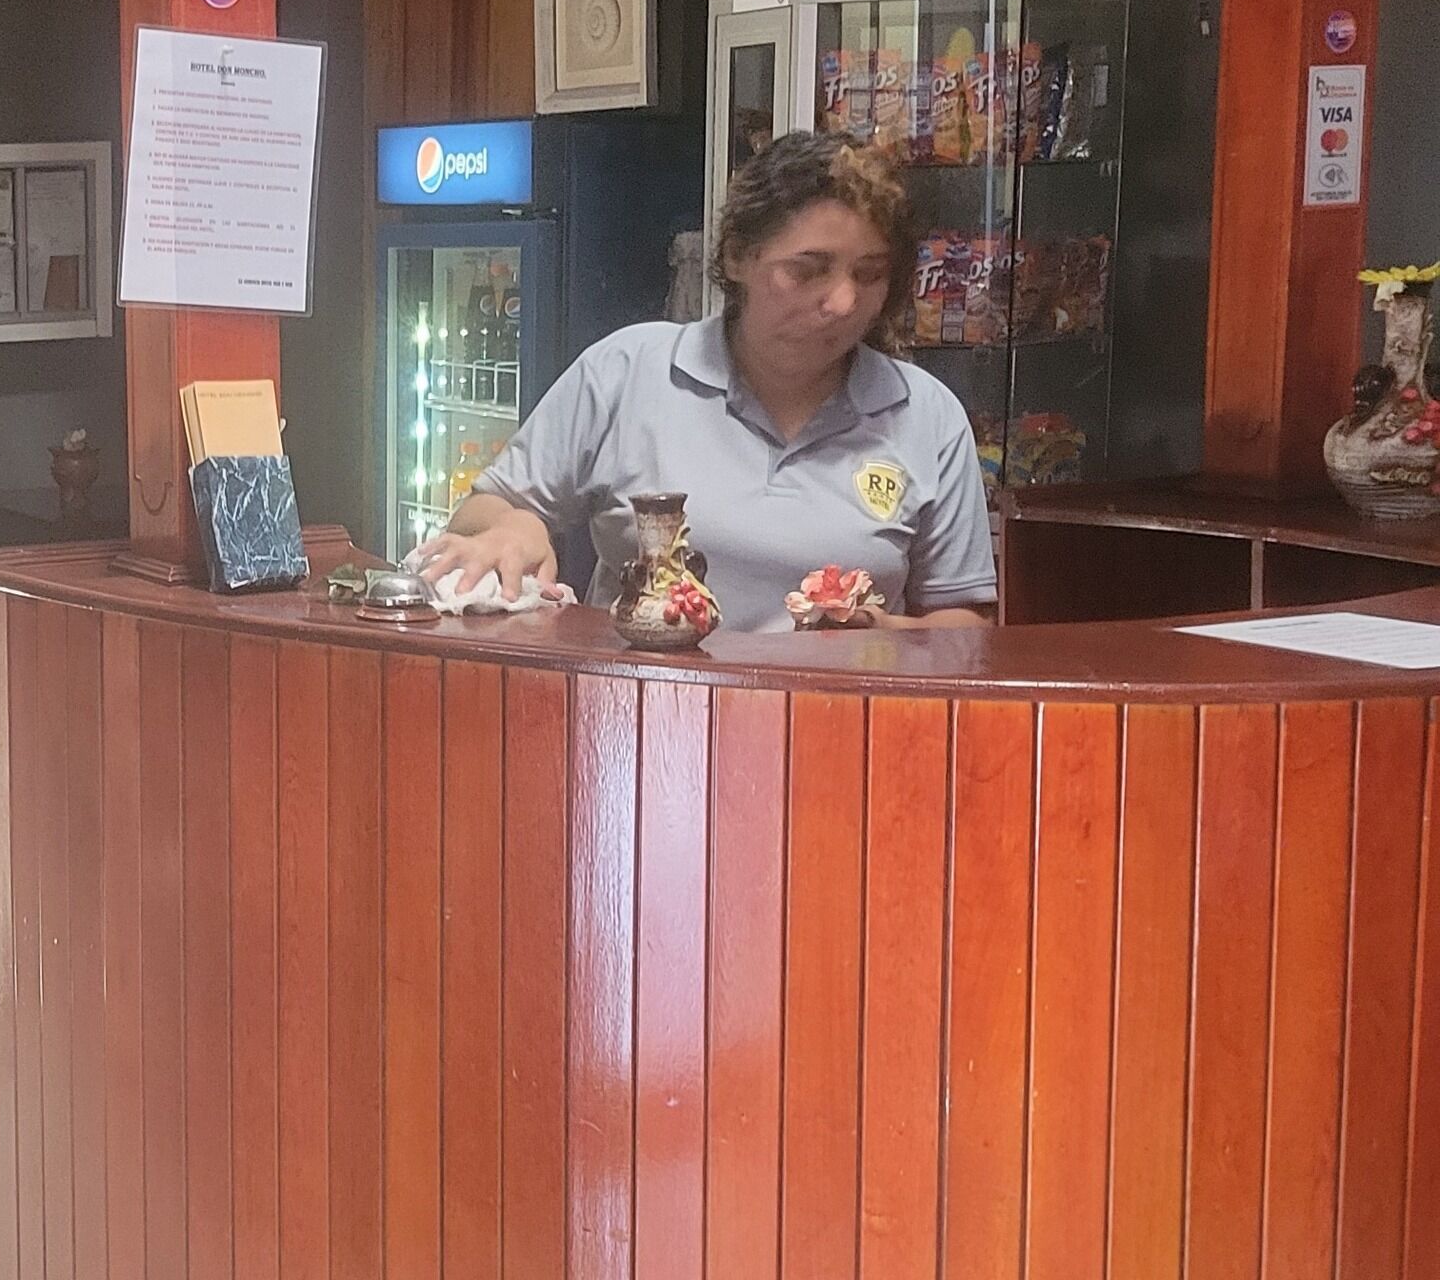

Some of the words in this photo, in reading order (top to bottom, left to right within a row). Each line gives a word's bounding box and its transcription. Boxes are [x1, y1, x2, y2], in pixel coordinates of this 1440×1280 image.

[190, 62, 216, 73] HOTEL
[217, 65, 233, 76] DON
[1319, 107, 1353, 123] VISA
[445, 147, 487, 180] pepsi
